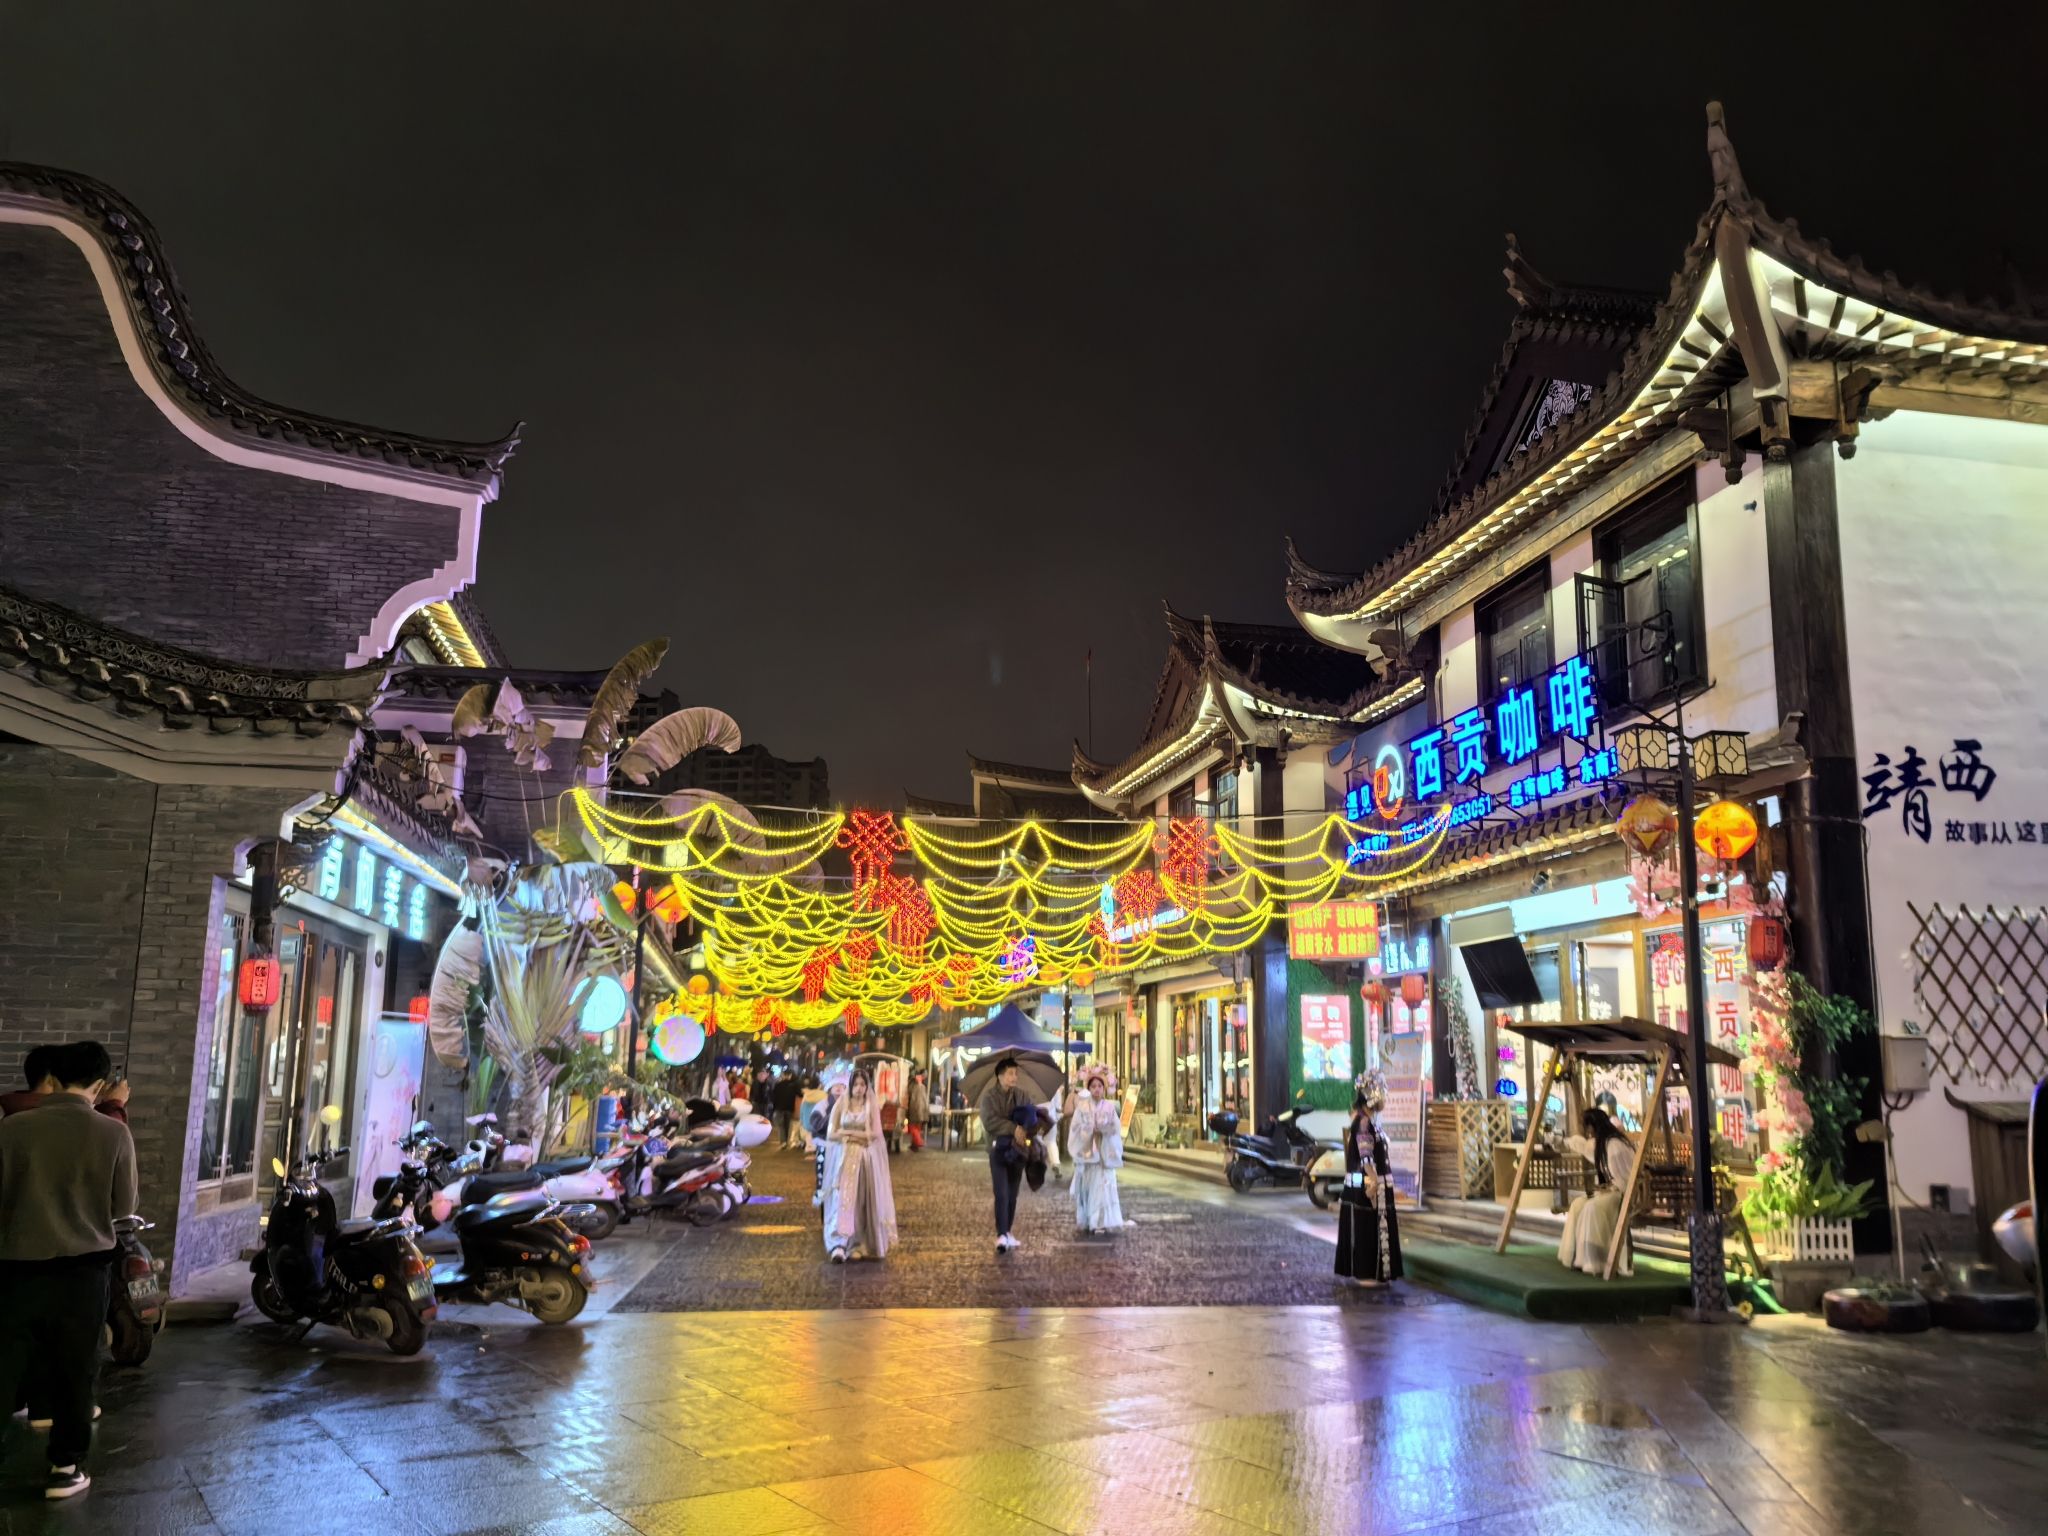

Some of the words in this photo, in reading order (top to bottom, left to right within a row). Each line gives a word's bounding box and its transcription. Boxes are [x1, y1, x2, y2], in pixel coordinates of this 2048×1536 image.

[1411, 656, 1595, 800] 西贡咖啡
[1861, 738, 1997, 844] 靖西
[1713, 947, 1745, 1147] 西贡咖啡
